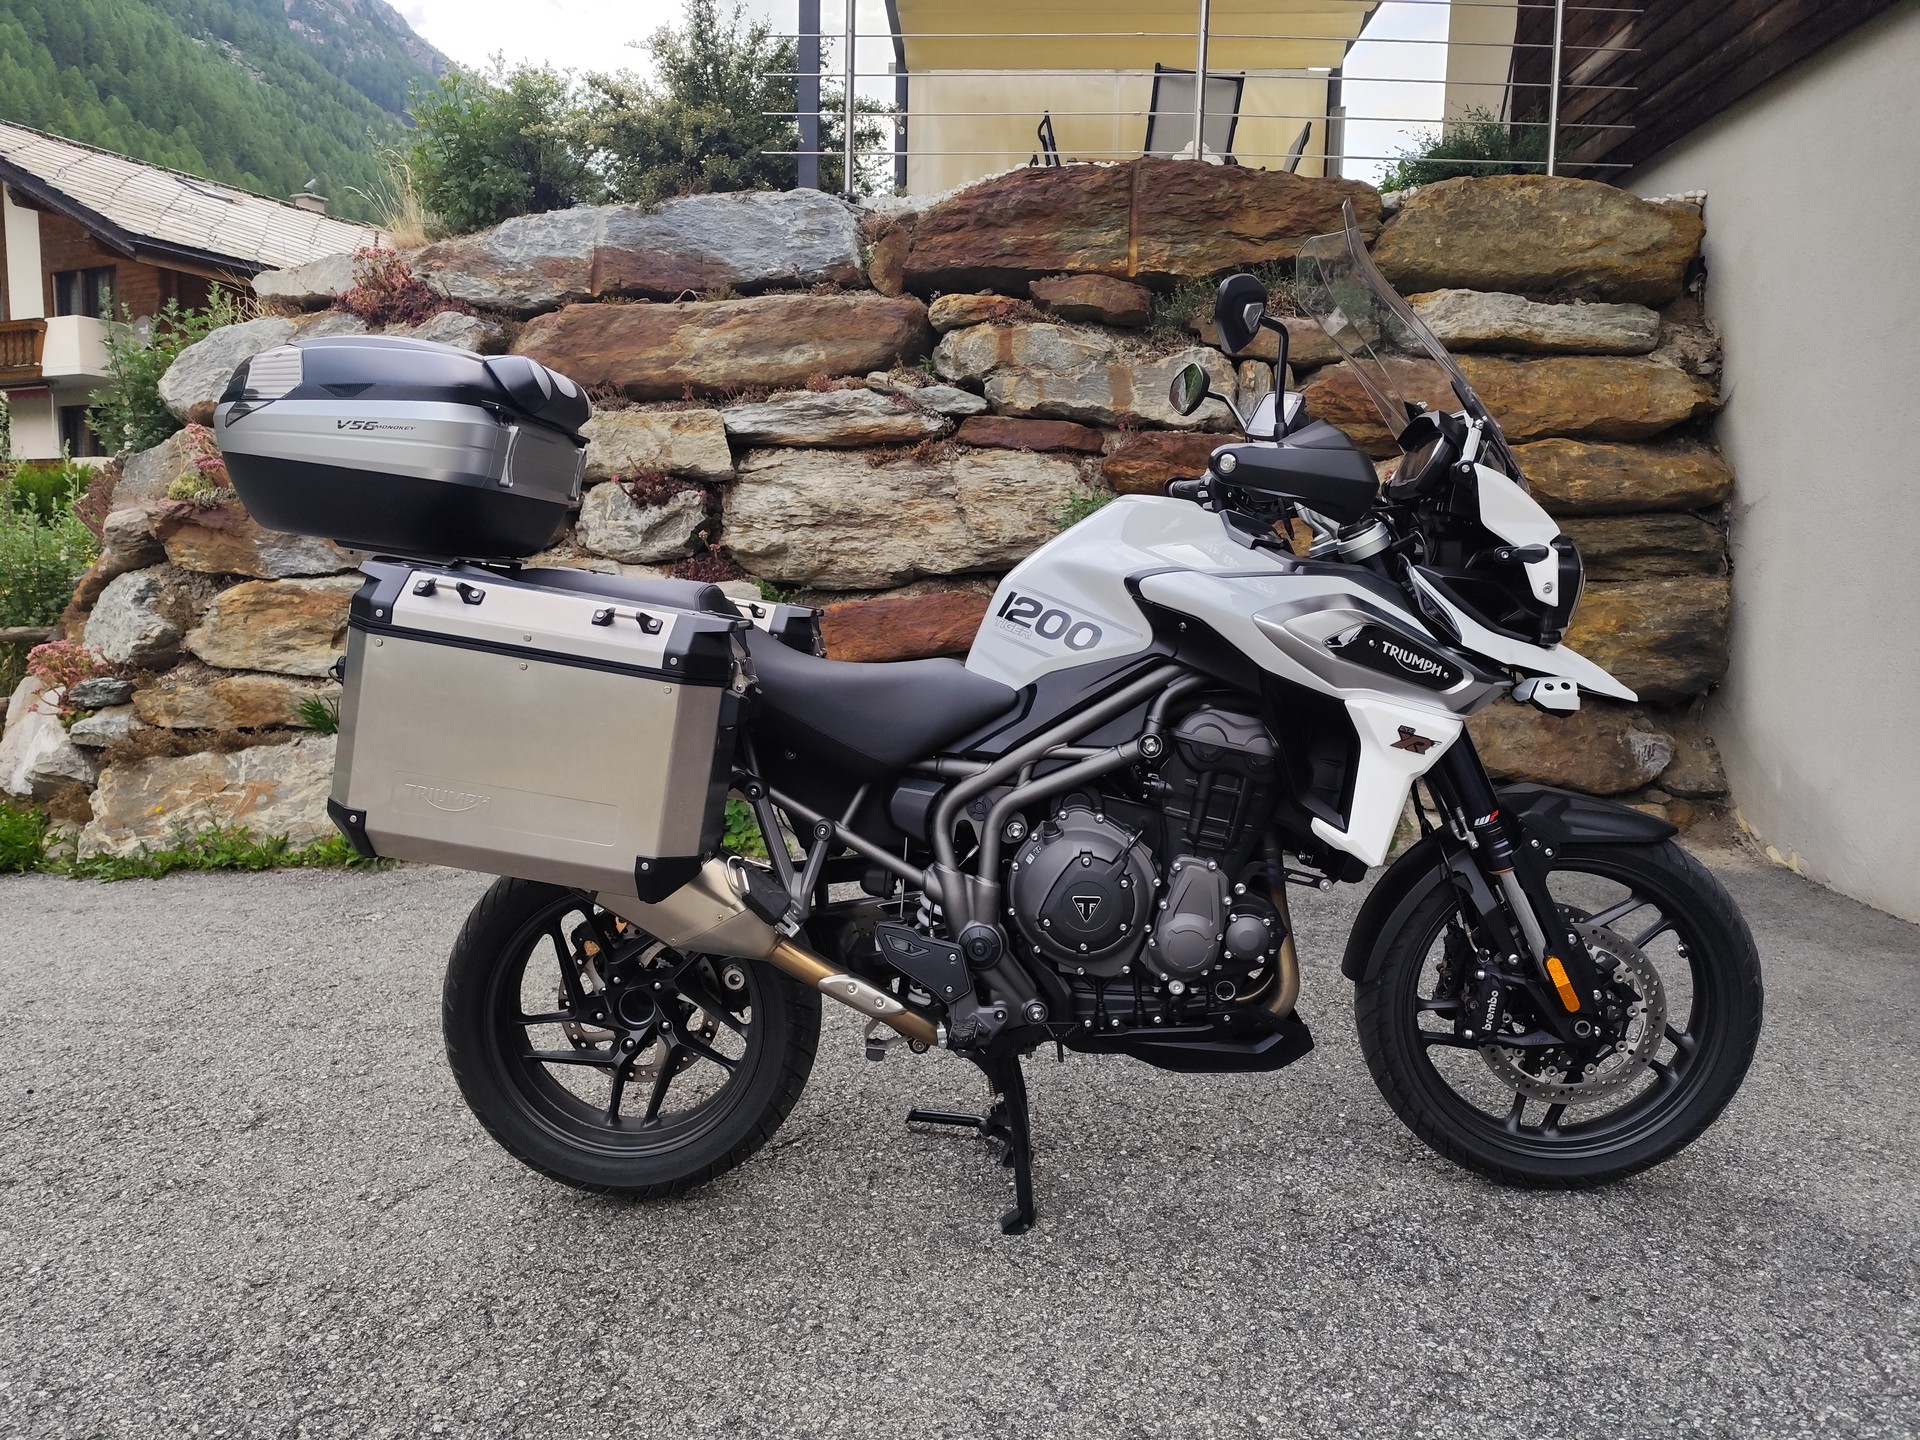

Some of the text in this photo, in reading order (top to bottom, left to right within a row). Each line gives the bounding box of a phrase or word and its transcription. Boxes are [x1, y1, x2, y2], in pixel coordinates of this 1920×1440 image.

[337, 419, 378, 431] V56
[994, 617, 1033, 640] TIGER
[996, 590, 1103, 652] 1200
[1382, 640, 1443, 677] TRIUMPH
[405, 783, 491, 812] TRIUMPH
[1481, 990, 1499, 1031] brembo
